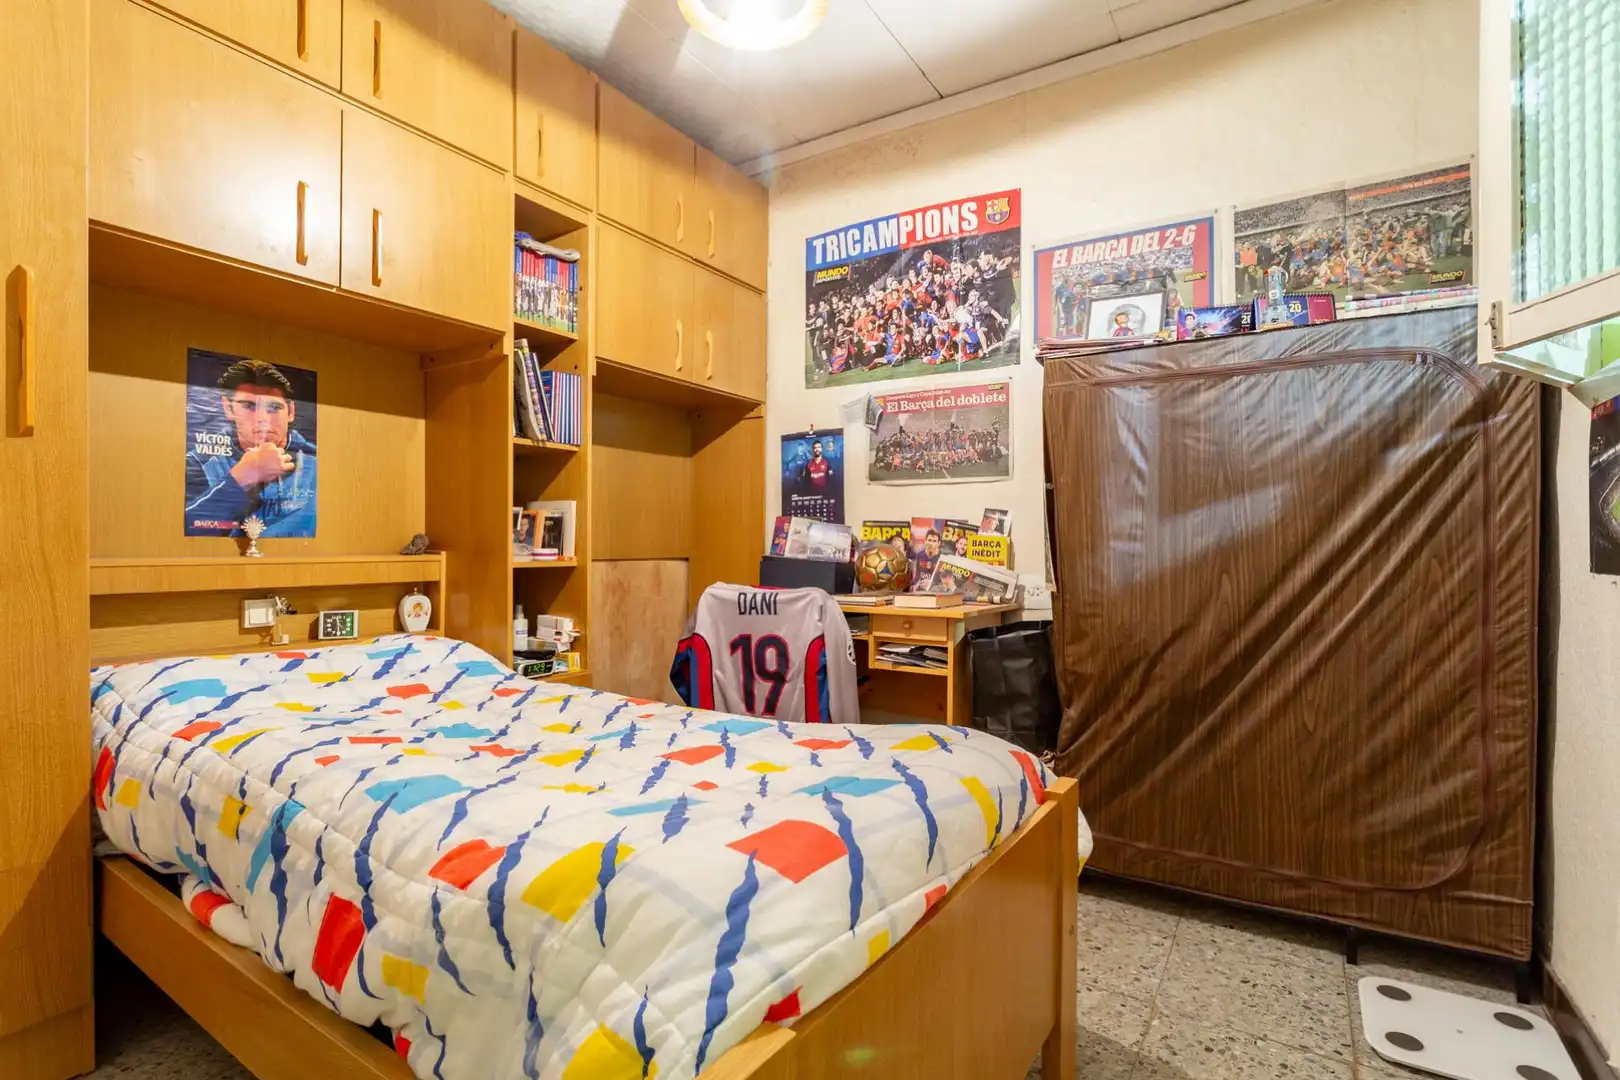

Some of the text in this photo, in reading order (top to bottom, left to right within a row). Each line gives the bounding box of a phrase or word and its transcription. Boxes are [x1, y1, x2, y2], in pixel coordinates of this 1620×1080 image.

[813, 201, 979, 265] TRICAMPIONS
[1052, 224, 1197, 268] EL BARÇA DEL 2-6
[817, 266, 848, 280] MUNDO
[1432, 271, 1463, 281] MUNDO
[1288, 303, 1302, 313] 20
[886, 402, 899, 412] El
[900, 400, 935, 412] Barça
[936, 396, 956, 408] del
[957, 392, 1007, 406] doblete
[195, 431, 231, 445] VÍCTOR
[971, 540, 1002, 549] BARÇA
[941, 563, 970, 577] MUNDO
[737, 592, 779, 616] DANI
[729, 633, 790, 717] 19
